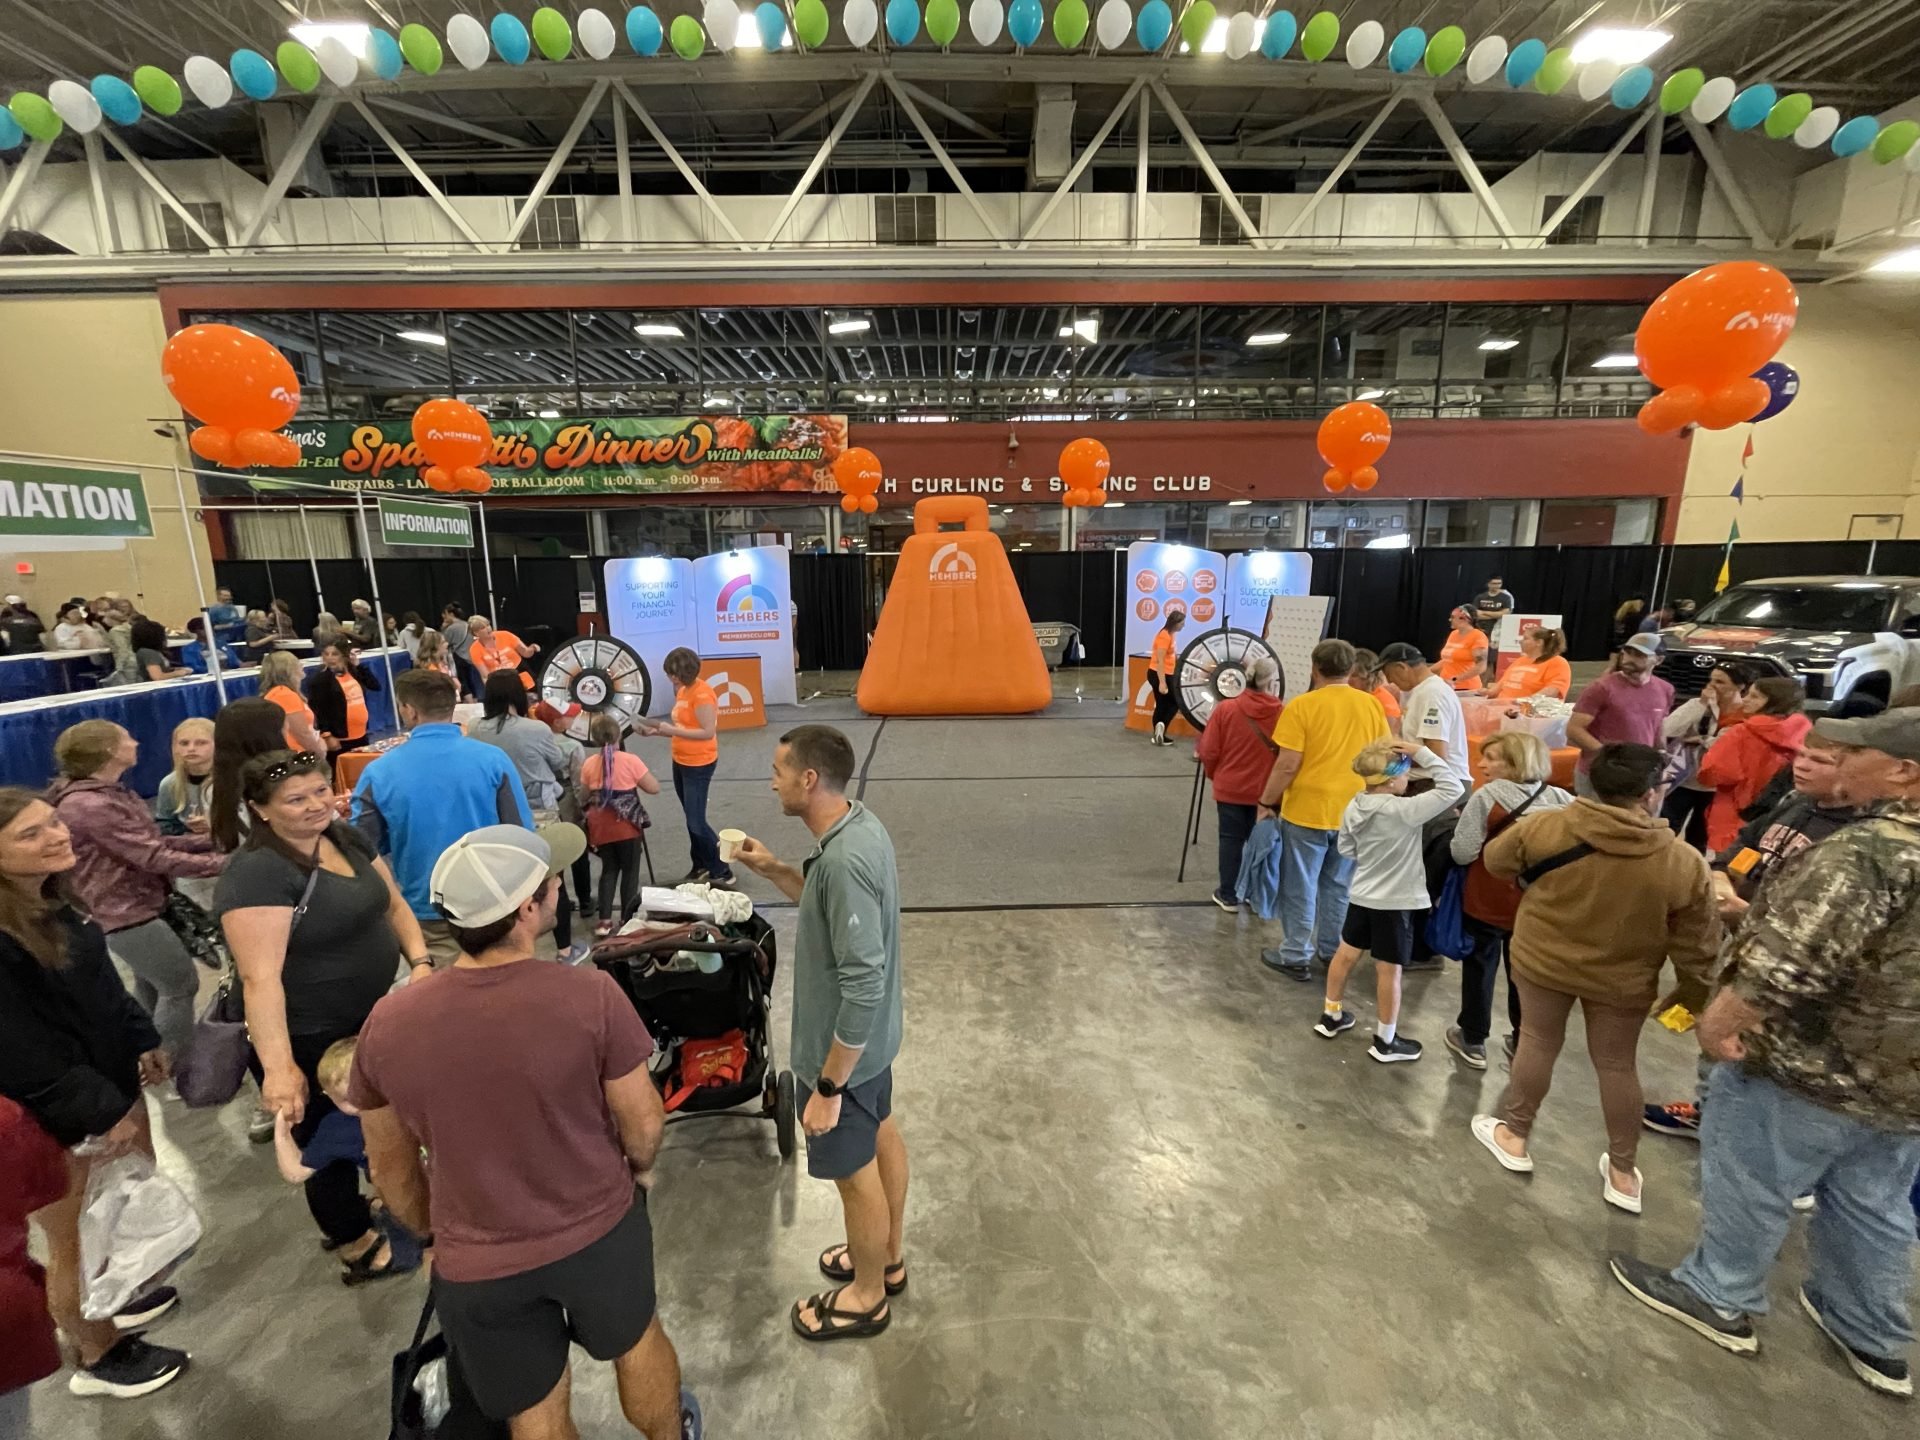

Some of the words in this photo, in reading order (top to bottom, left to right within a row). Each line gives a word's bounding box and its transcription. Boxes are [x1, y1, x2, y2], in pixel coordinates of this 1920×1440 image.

[443, 431, 482, 442] MEMBERS
[544, 424, 713, 469] Dinner
[707, 449, 740, 461] With
[743, 448, 823, 460] Meatballs!
[330, 479, 394, 489] UPSTAIRS
[512, 477, 585, 488] BALLROOM
[603, 476, 632, 486] 11:00
[635, 477, 657, 486] a.m.
[670, 475, 699, 485] 9:00
[701, 476, 722, 486] p.m.
[911, 477, 1004, 493] CURLING
[1021, 476, 1033, 492] &
[1153, 476, 1211, 491] CLUB
[385, 512, 469, 535] INFORMATION
[929, 571, 977, 581] MEMBERS
[625, 581, 679, 591] SUPPORTING
[1253, 577, 1278, 586] YOUR
[642, 591, 665, 599] YOUR
[1240, 587, 1279, 597] SUCCESS
[631, 600, 676, 610] FINANCIAL
[1240, 597, 1259, 607] OUR
[636, 609, 673, 619] JOURNEY
[717, 611, 780, 623] MEMBERS
